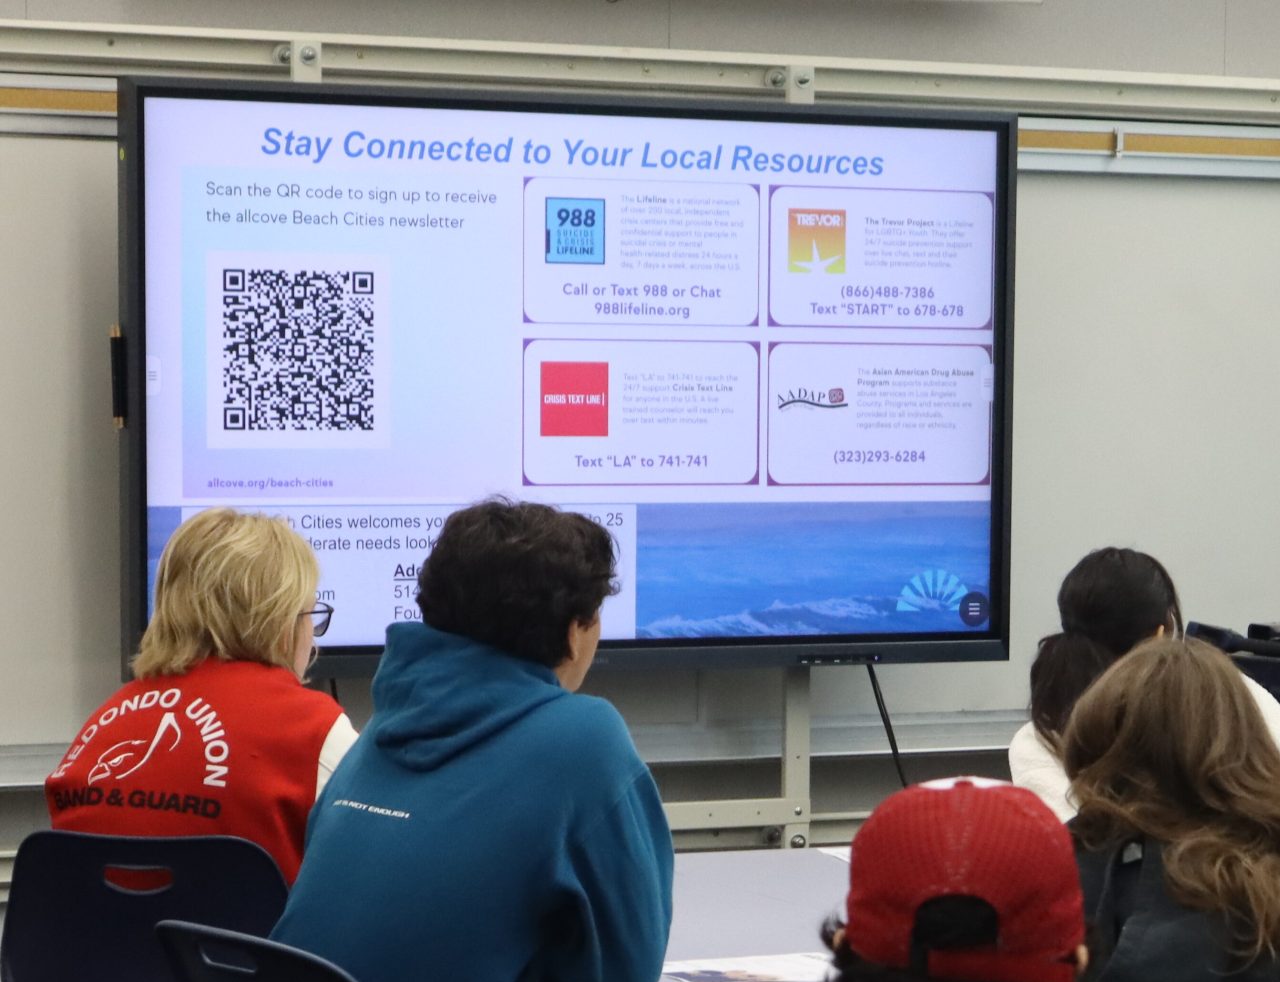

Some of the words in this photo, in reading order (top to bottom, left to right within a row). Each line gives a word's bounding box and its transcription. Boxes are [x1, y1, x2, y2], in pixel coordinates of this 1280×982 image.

[261, 127, 333, 164] Stay
[344, 130, 514, 163] Connected
[523, 139, 552, 164] to
[564, 139, 633, 167] Your
[641, 141, 723, 171] Local
[731, 145, 885, 176] Resources
[206, 182, 242, 197] Scan
[247, 183, 272, 198] the
[276, 184, 301, 198] QR
[305, 185, 343, 200] code
[348, 187, 363, 200] to
[368, 186, 397, 204] sign
[402, 190, 421, 204] up
[425, 188, 440, 202] to
[445, 190, 497, 204] receive
[637, 195, 667, 204] Lifeline
[206, 209, 231, 223] the
[235, 209, 288, 224] allcove
[292, 210, 338, 225] Beach
[343, 211, 384, 226] Cities
[389, 213, 465, 228] newsletter
[557, 208, 595, 227] 988
[797, 213, 841, 226] TREVOR
[865, 217, 879, 226] The
[882, 217, 904, 226] Trevor
[907, 217, 934, 228] Project
[557, 246, 595, 255] LIFELINE
[562, 282, 588, 295] Call
[592, 286, 606, 296] or
[610, 283, 639, 296] Text
[643, 284, 668, 297] 988
[672, 287, 686, 297] or
[690, 285, 722, 298] Chat
[841, 286, 934, 299] (866)488-7386
[594, 302, 690, 319] 988lifeline.org
[810, 302, 837, 314] Text
[897, 305, 910, 315] to
[914, 304, 964, 316] 678-678
[872, 368, 893, 376] Asian
[895, 368, 929, 377] American
[931, 368, 950, 378] Drug
[951, 368, 974, 377] Abuse
[672, 383, 695, 392] Crisis
[697, 383, 713, 392] Text
[715, 384, 734, 392] Line
[857, 378, 890, 388] Program
[544, 394, 567, 404] CRISIS
[568, 394, 585, 404] TEXT
[586, 394, 601, 404] LINE
[778, 387, 826, 404] AADAP
[574, 454, 603, 467] Text
[641, 457, 654, 467] to
[658, 454, 708, 467] 741-741
[833, 450, 926, 464] (323)293-6284
[207, 477, 334, 490] allcove.org/beach-cities
[301, 514, 343, 529] Cities
[347, 515, 421, 529] welcomes
[426, 517, 446, 531] yo
[606, 513, 624, 526] 25
[356, 536, 401, 550] needs
[51, 688, 182, 779] REDONDO
[185, 697, 230, 788] UNION
[54, 787, 104, 811] BAND
[105, 788, 125, 807] &
[127, 790, 222, 819] GUARD
[348, 801, 368, 810] NOT
[368, 806, 410, 819] ENOUGH
